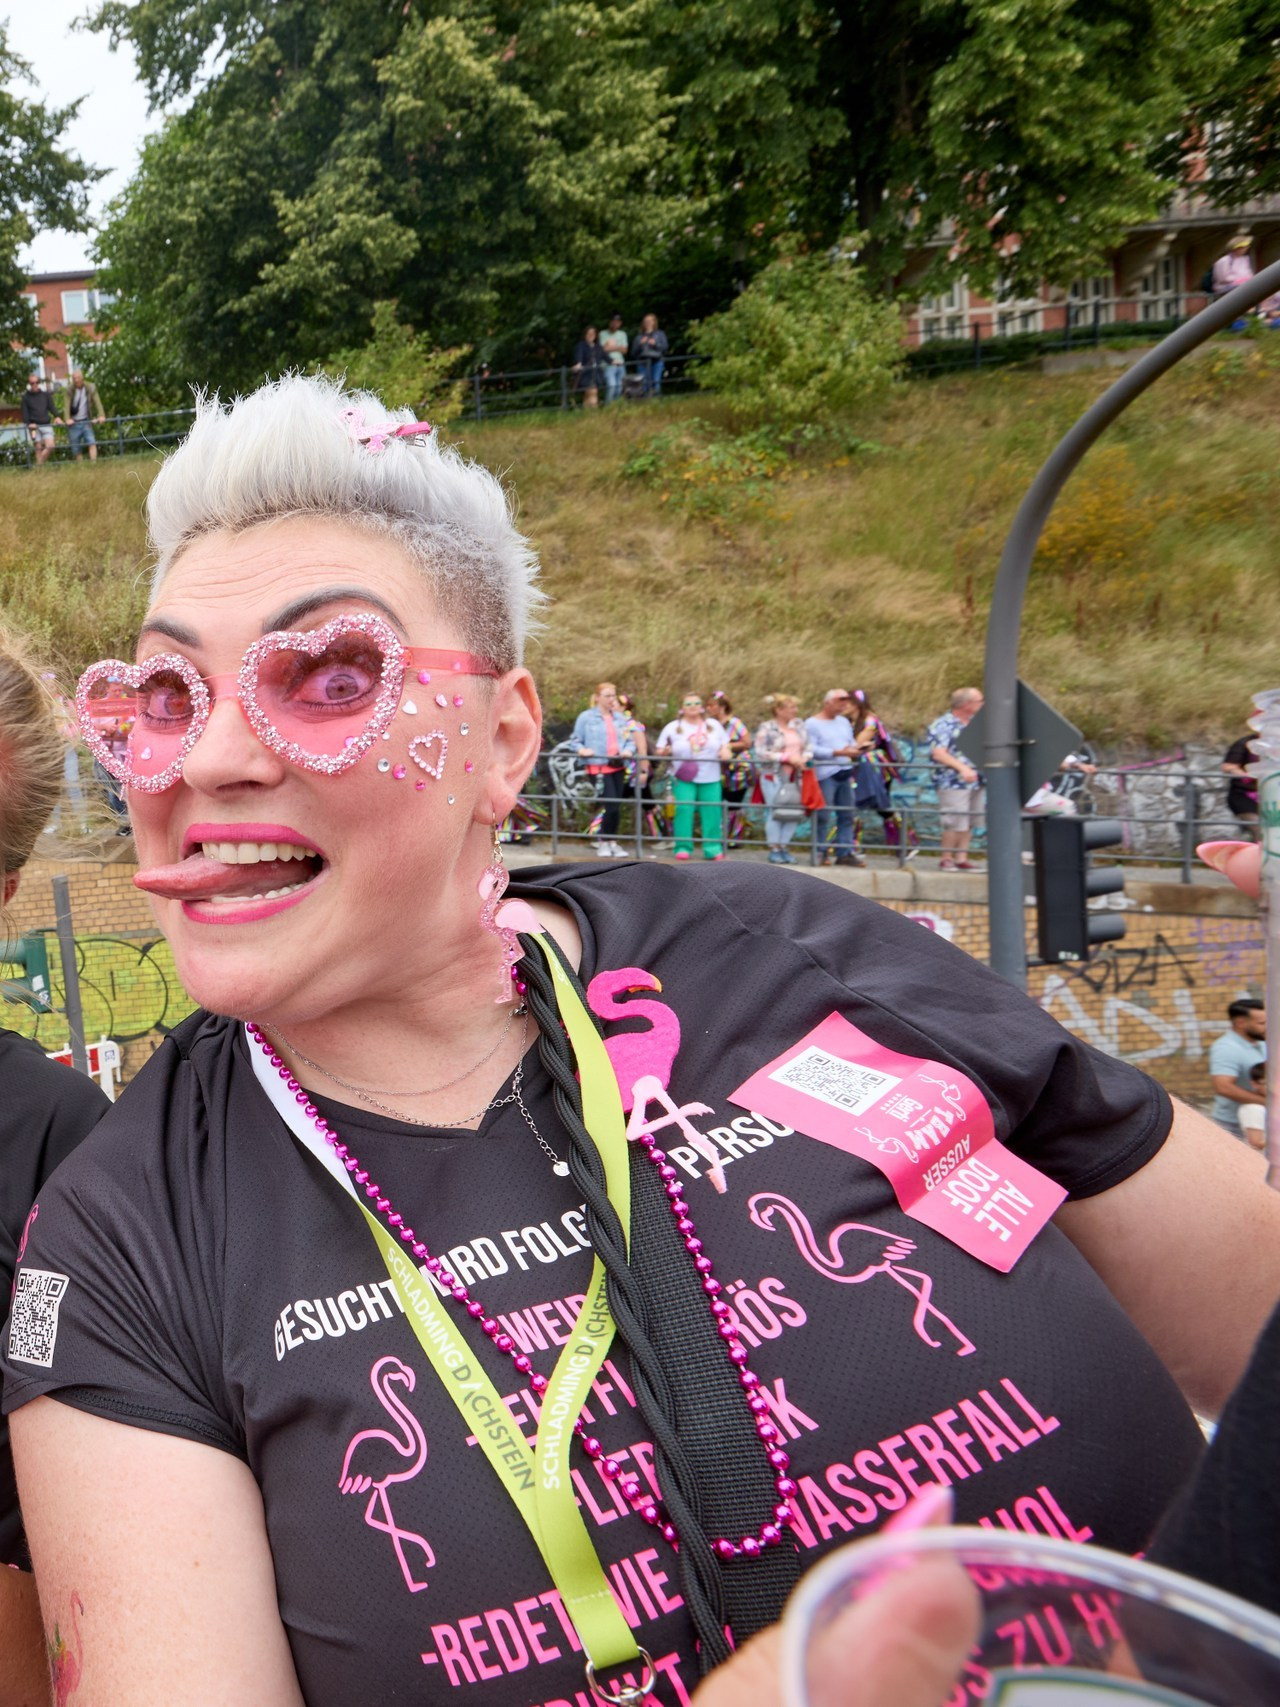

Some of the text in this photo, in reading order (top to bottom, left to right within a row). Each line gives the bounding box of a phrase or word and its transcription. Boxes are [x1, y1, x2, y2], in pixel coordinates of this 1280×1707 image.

[903, 1106, 955, 1150] TEAM
[922, 1133, 971, 1191] AUSSER
[941, 1156, 1001, 1215] DOOF
[973, 1179, 1035, 1243] ALLE
[274, 1279, 405, 1362] GESUCHT
